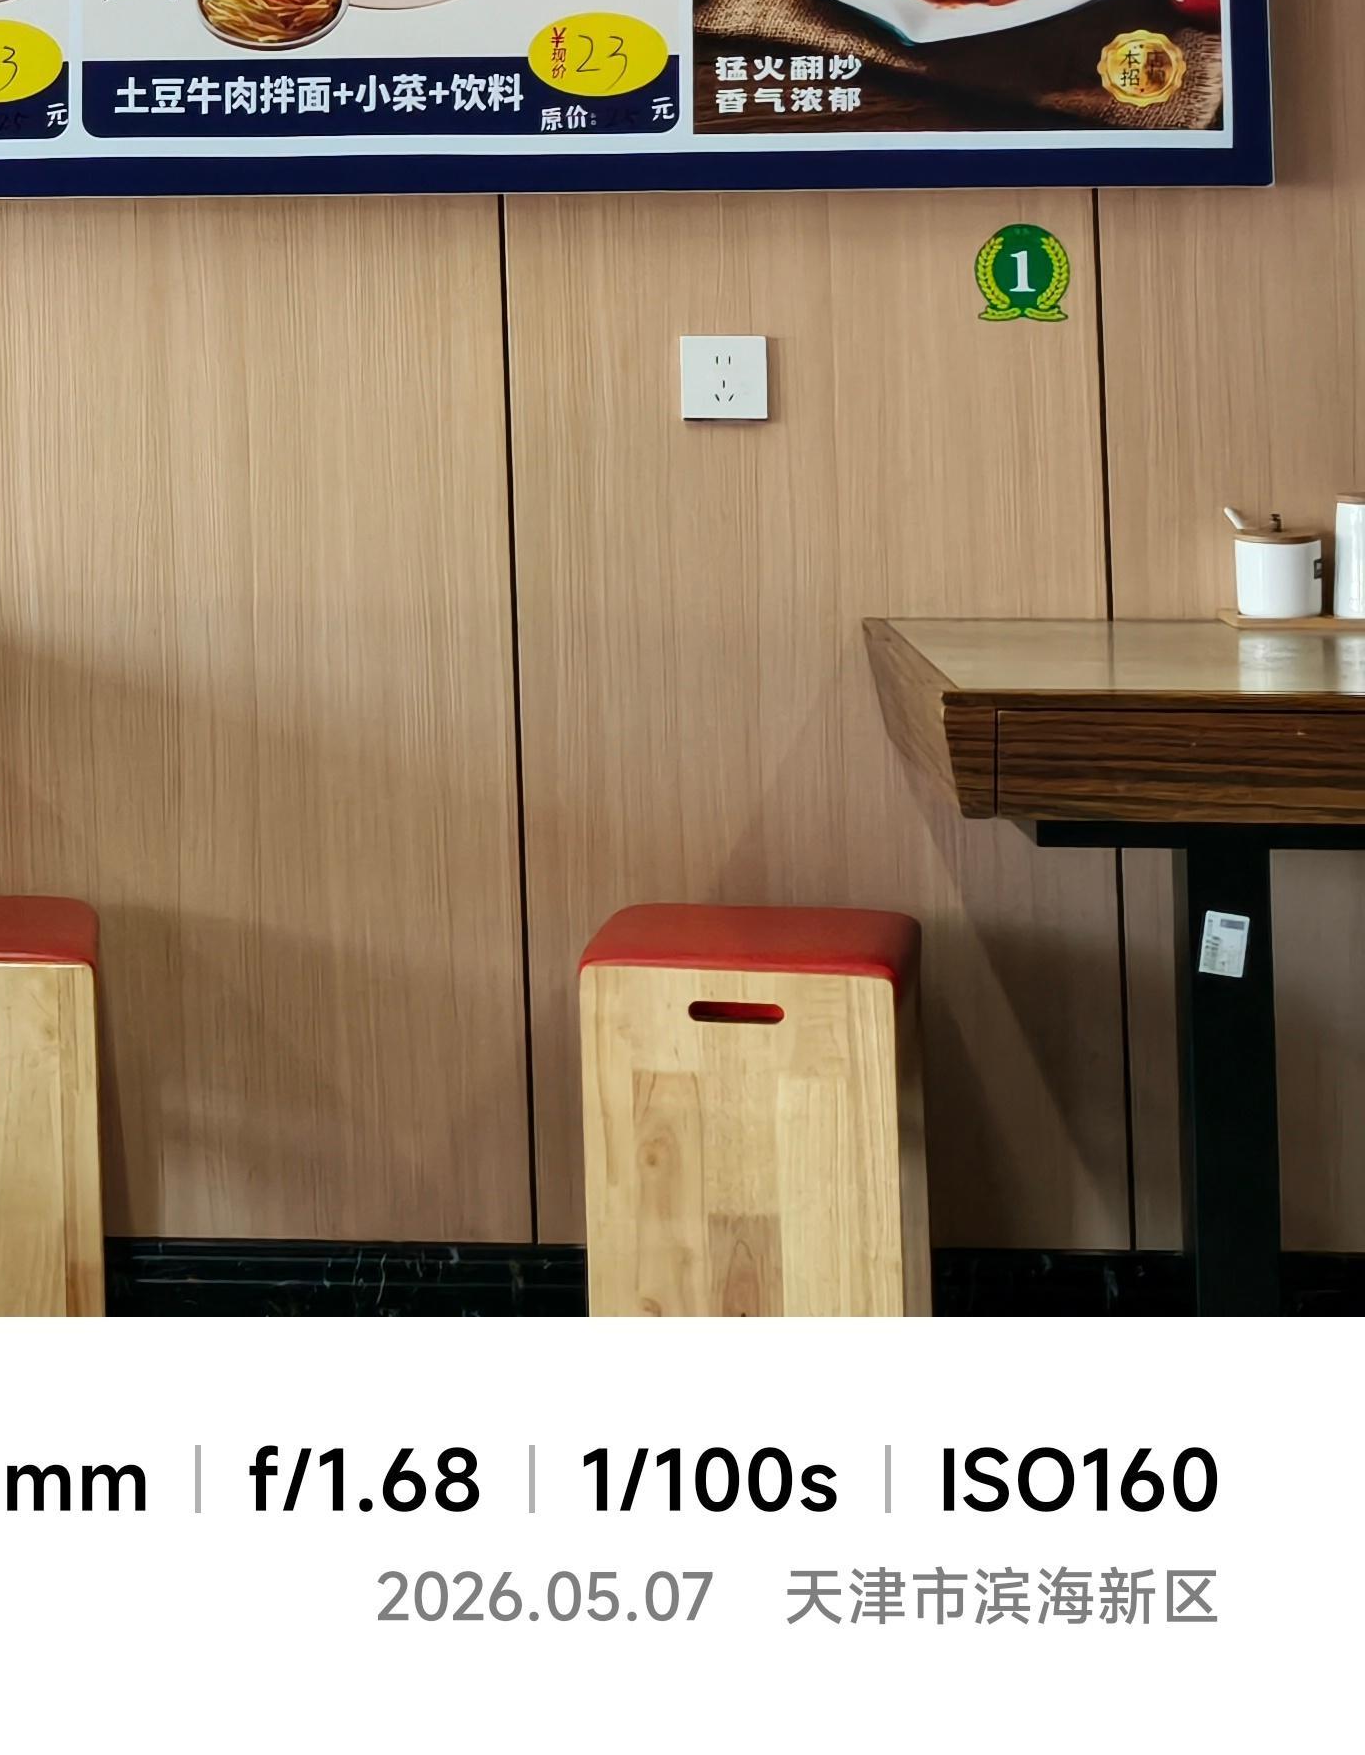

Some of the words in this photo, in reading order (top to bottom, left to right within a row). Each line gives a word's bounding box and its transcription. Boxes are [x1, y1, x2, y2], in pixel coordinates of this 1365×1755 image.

[576, 35, 629, 91] 23
[715, 55, 863, 82] 猛火翻炒
[114, 73, 523, 115] 土豆牛肉拌面+小菜+饮料
[715, 86, 862, 113] 香气浓郁
[47, 103, 68, 127] 元
[651, 96, 675, 120] 元
[1009, 250, 1035, 292] 1
